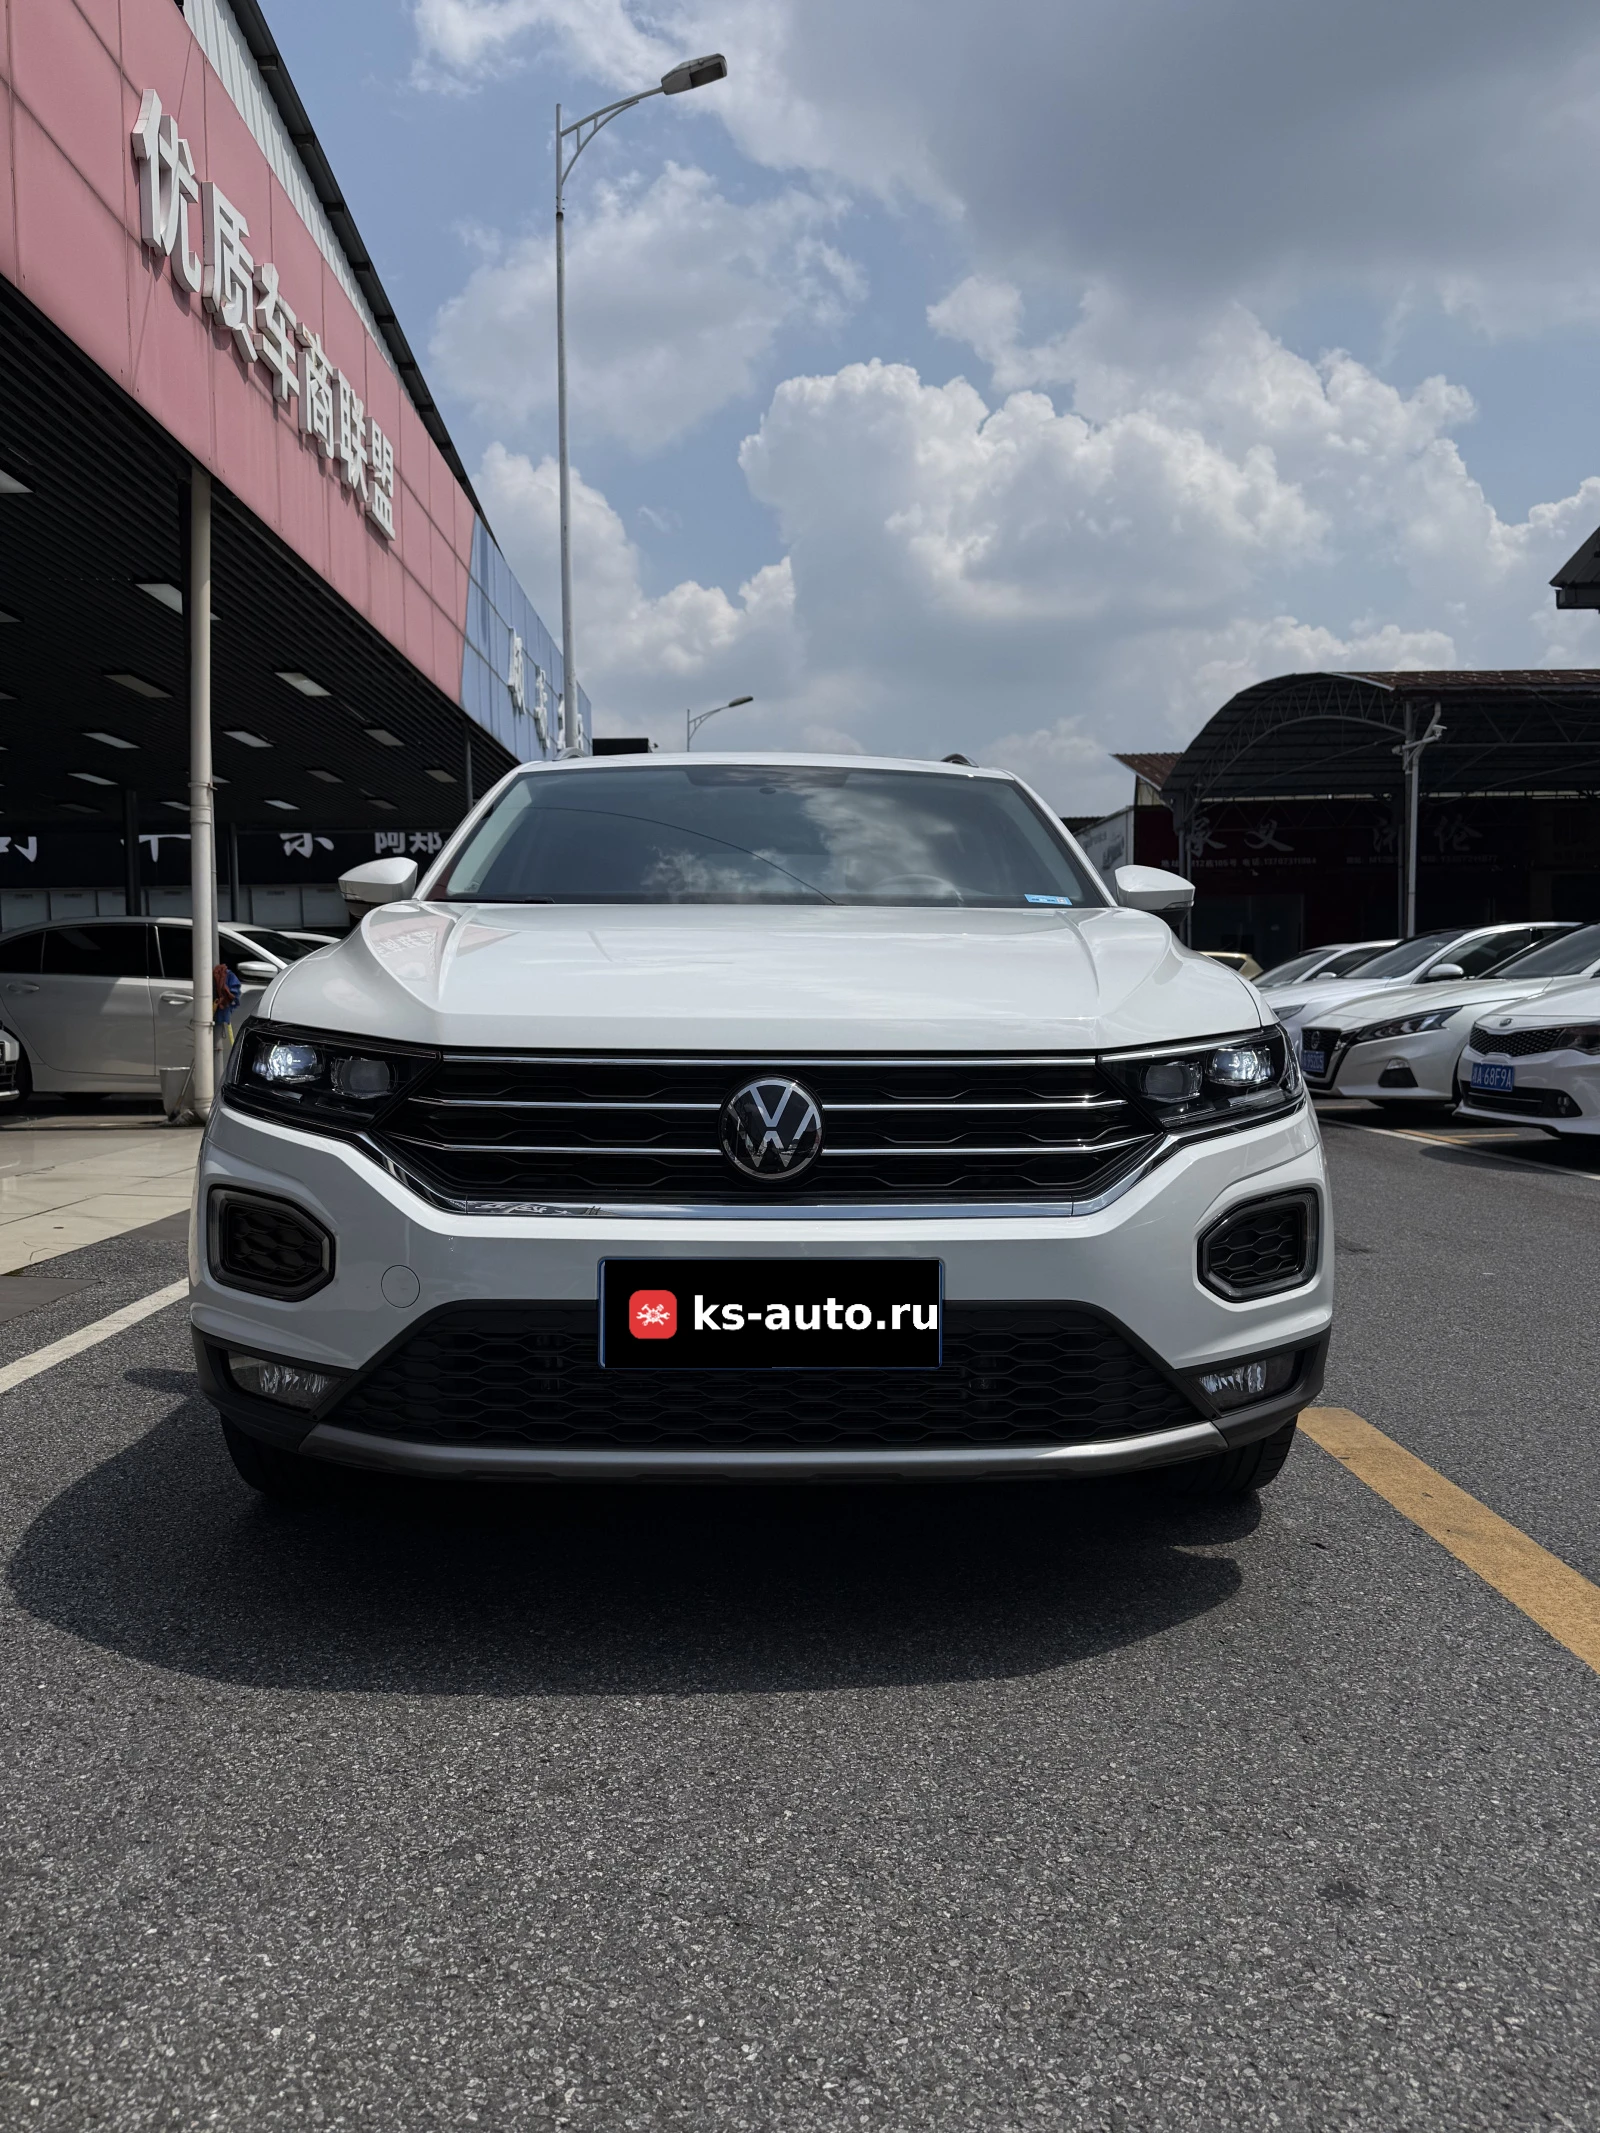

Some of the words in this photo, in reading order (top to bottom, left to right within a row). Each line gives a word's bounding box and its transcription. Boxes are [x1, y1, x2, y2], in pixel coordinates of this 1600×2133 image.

[132, 88, 396, 541] 优质车商联盟
